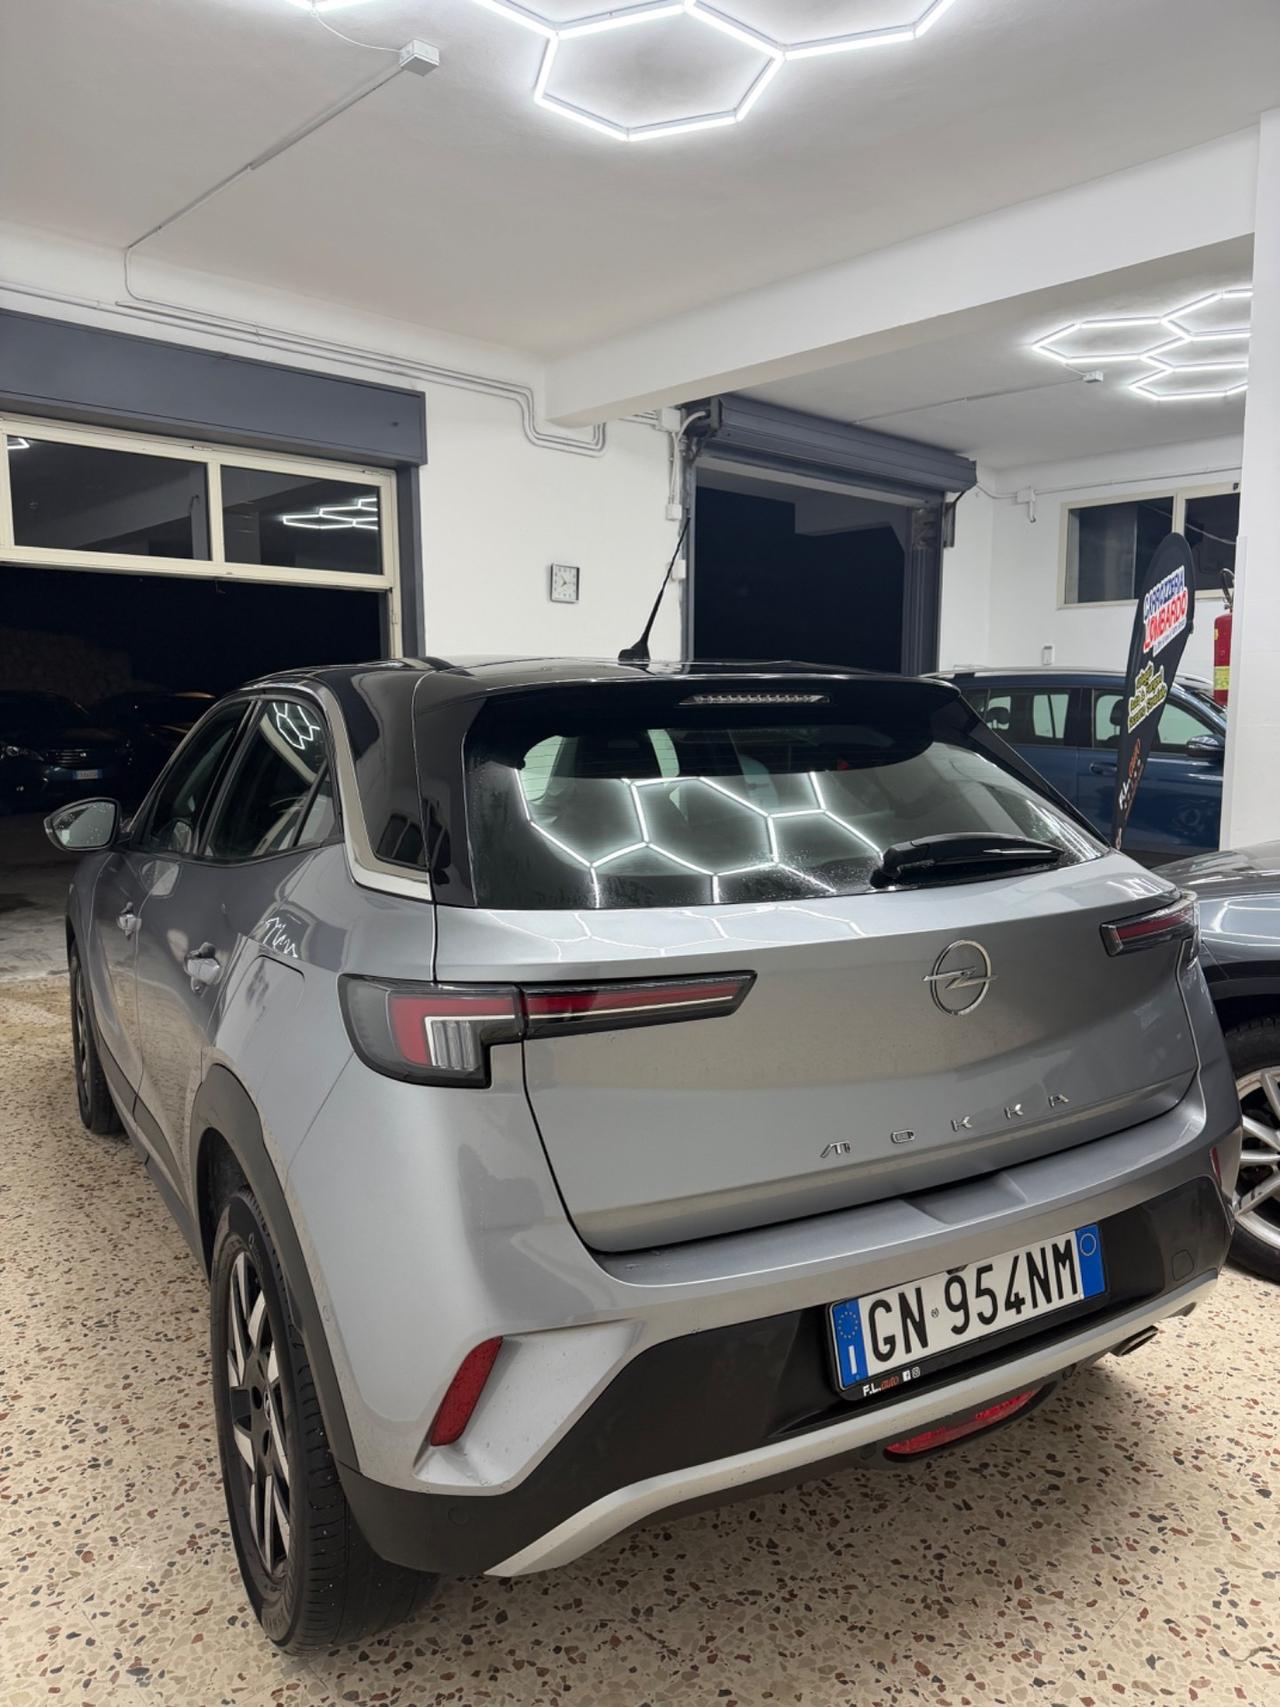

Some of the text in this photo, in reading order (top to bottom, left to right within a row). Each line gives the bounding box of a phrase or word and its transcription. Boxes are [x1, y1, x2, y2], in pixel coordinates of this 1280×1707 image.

[1144, 568, 1183, 619] CARROZZERIA
[1144, 588, 1187, 651] LOMBARDO
[821, 1094, 1069, 1158] MOKKA
[868, 1239, 1079, 1362] GN 954NM
[848, 1345, 857, 1375] I
